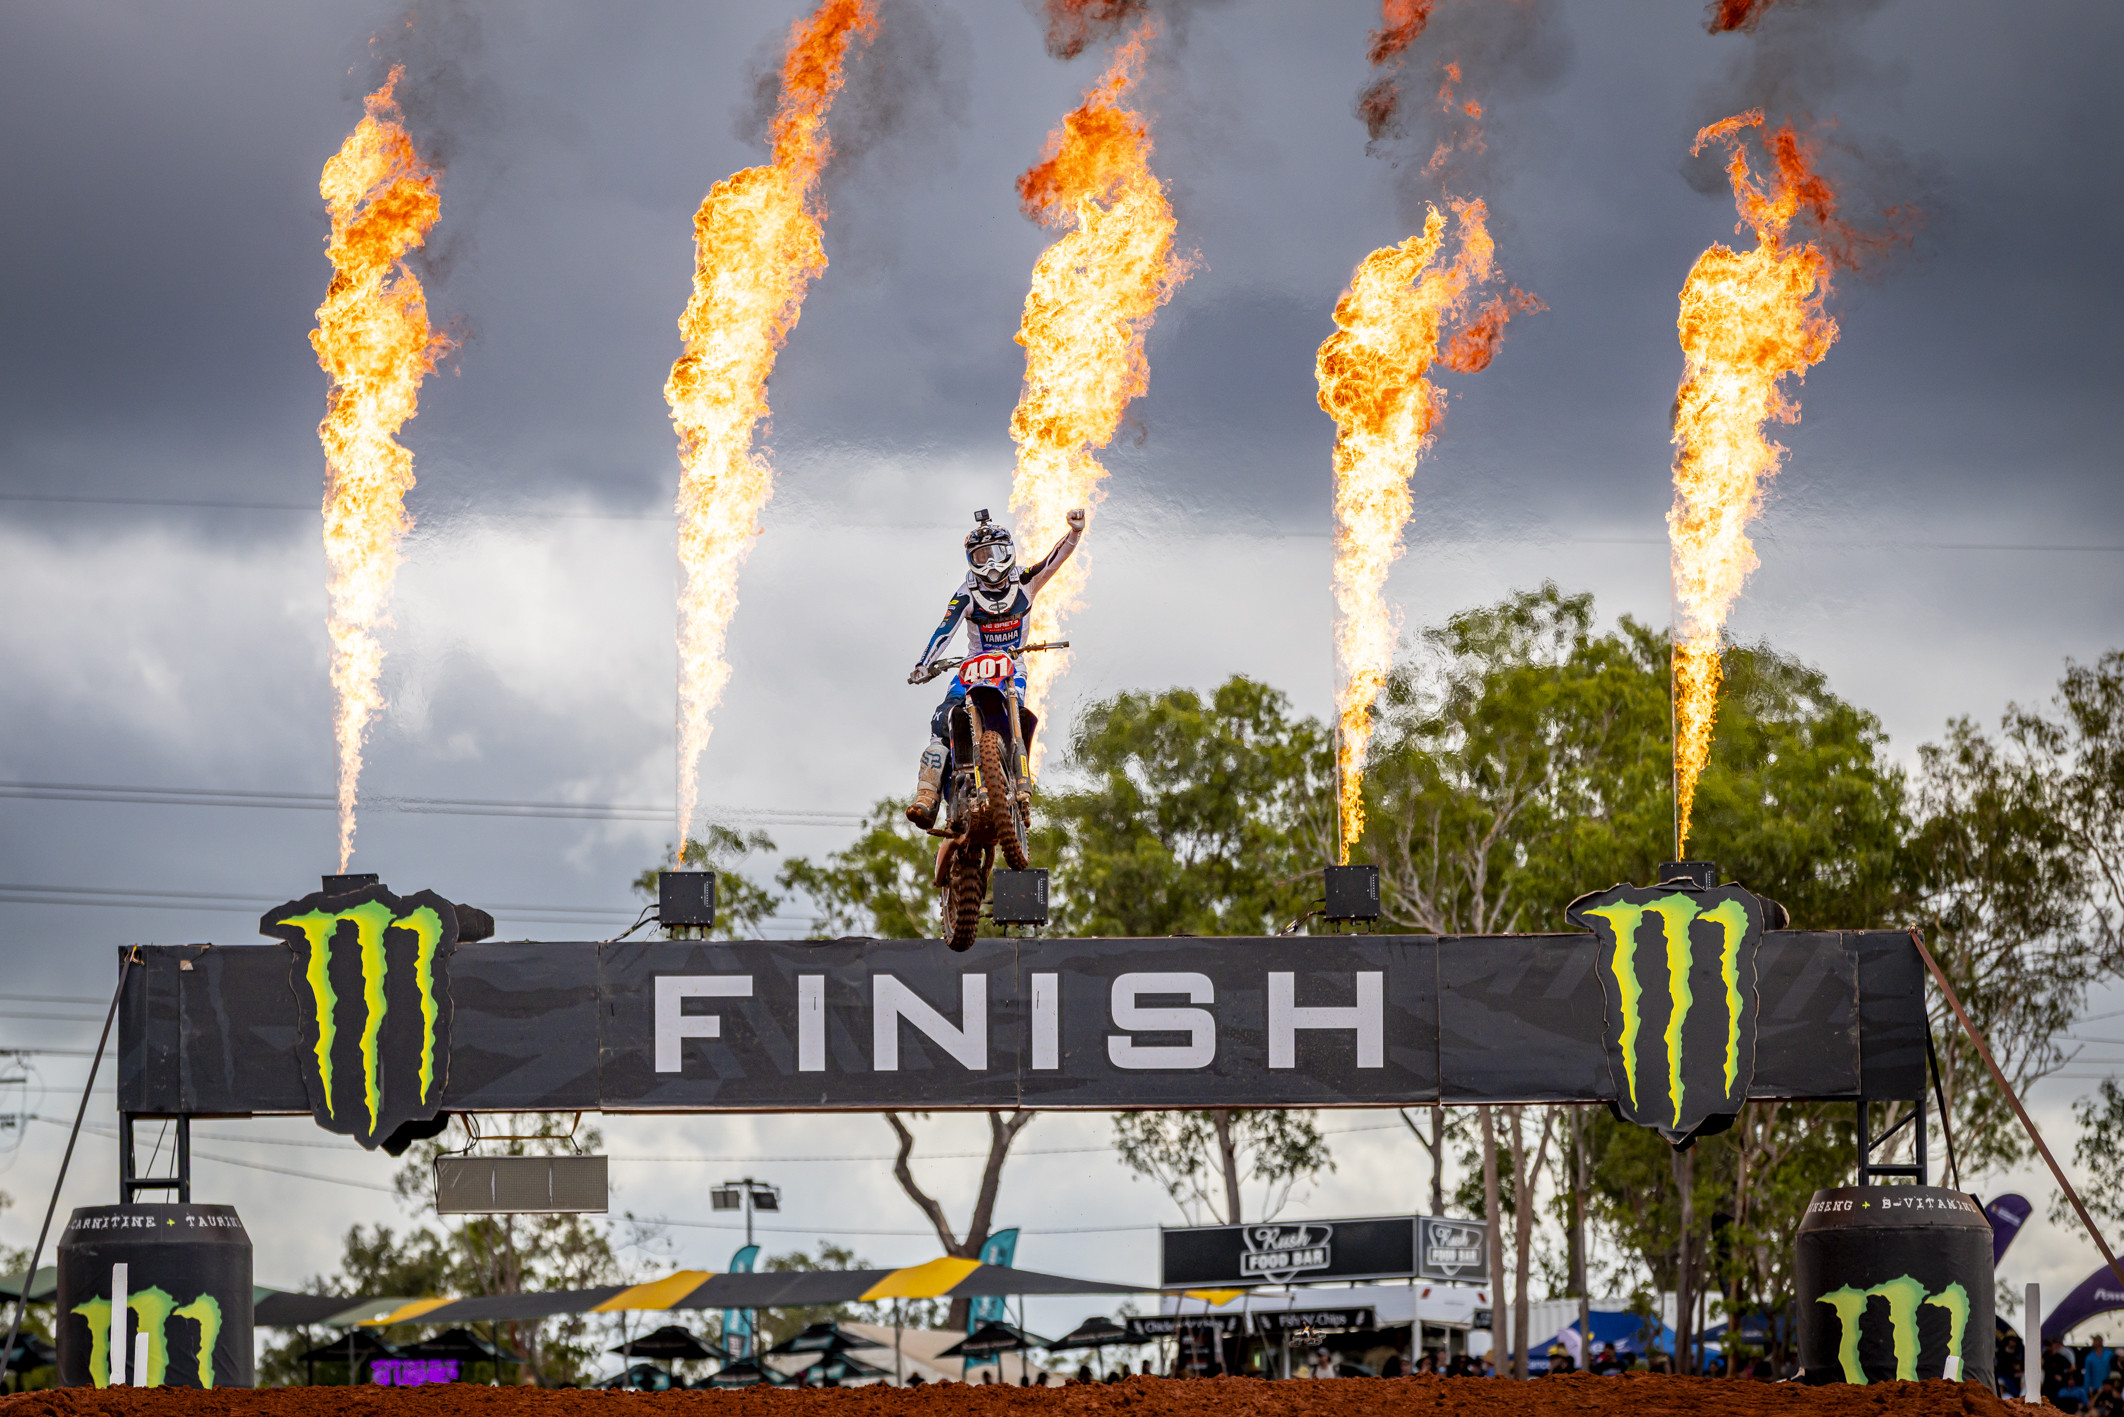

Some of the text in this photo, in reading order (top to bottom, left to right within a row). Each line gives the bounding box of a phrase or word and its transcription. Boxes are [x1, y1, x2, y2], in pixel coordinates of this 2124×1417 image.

[984, 629, 1019, 643] YAMAHA
[964, 657, 1008, 682] 401
[655, 971, 1384, 1072] FINISH
[1255, 1224, 1312, 1251] Rush
[1249, 1248, 1325, 1270] FOOD BAR
[1432, 1248, 1478, 1262] FOOD BAR
